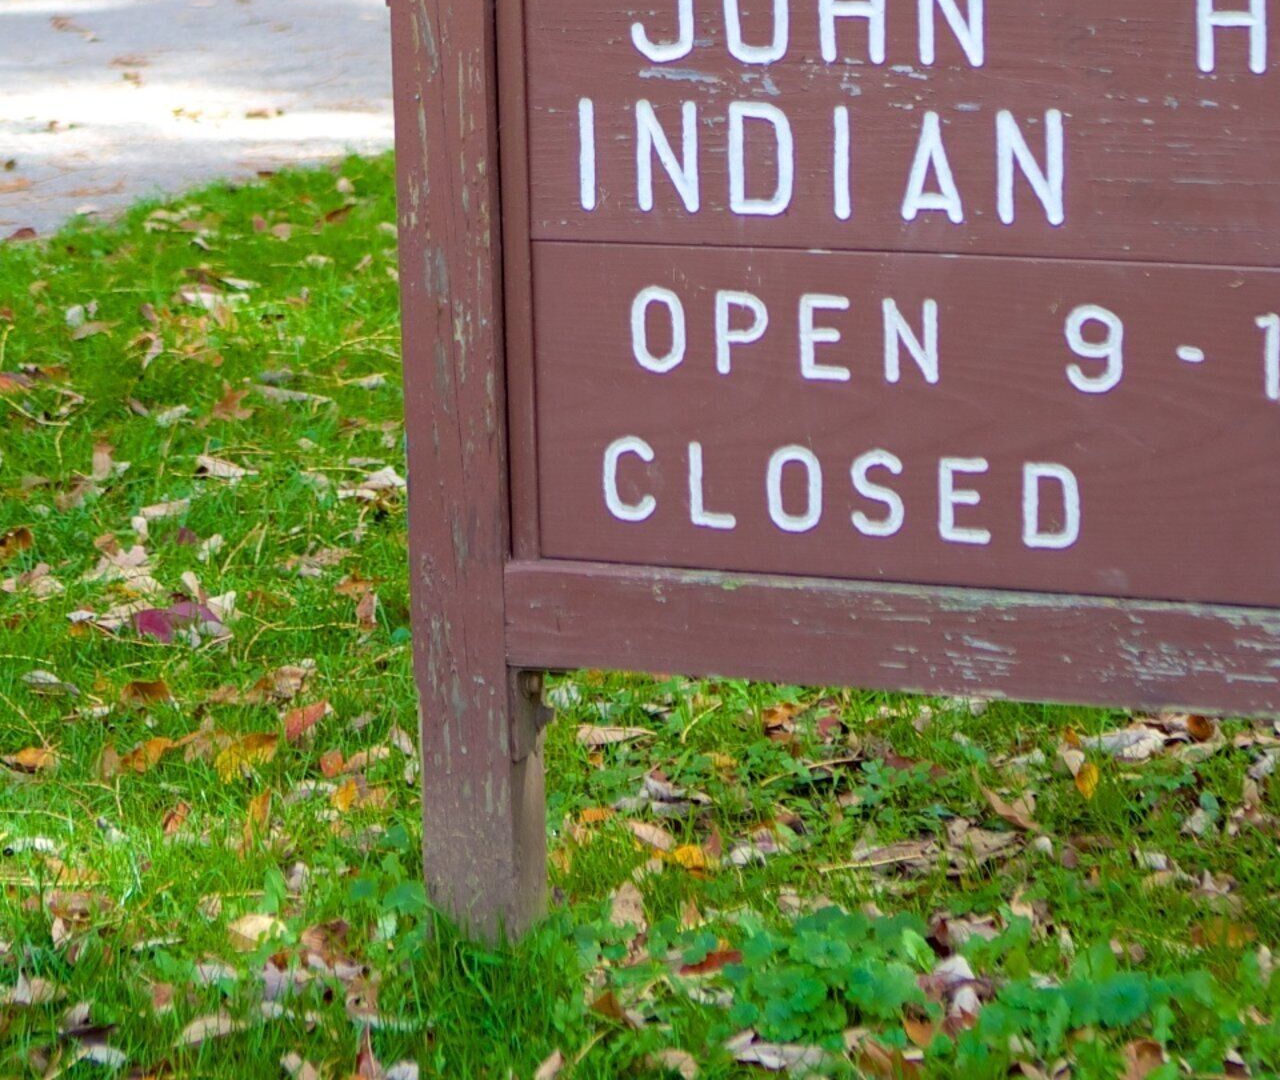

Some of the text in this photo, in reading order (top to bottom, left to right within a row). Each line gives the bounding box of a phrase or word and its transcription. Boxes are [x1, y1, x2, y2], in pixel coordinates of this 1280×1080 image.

[576, 95, 1066, 228] INDIAN
[628, 283, 941, 386] OPEN
[601, 433, 1082, 550] CLOSED
